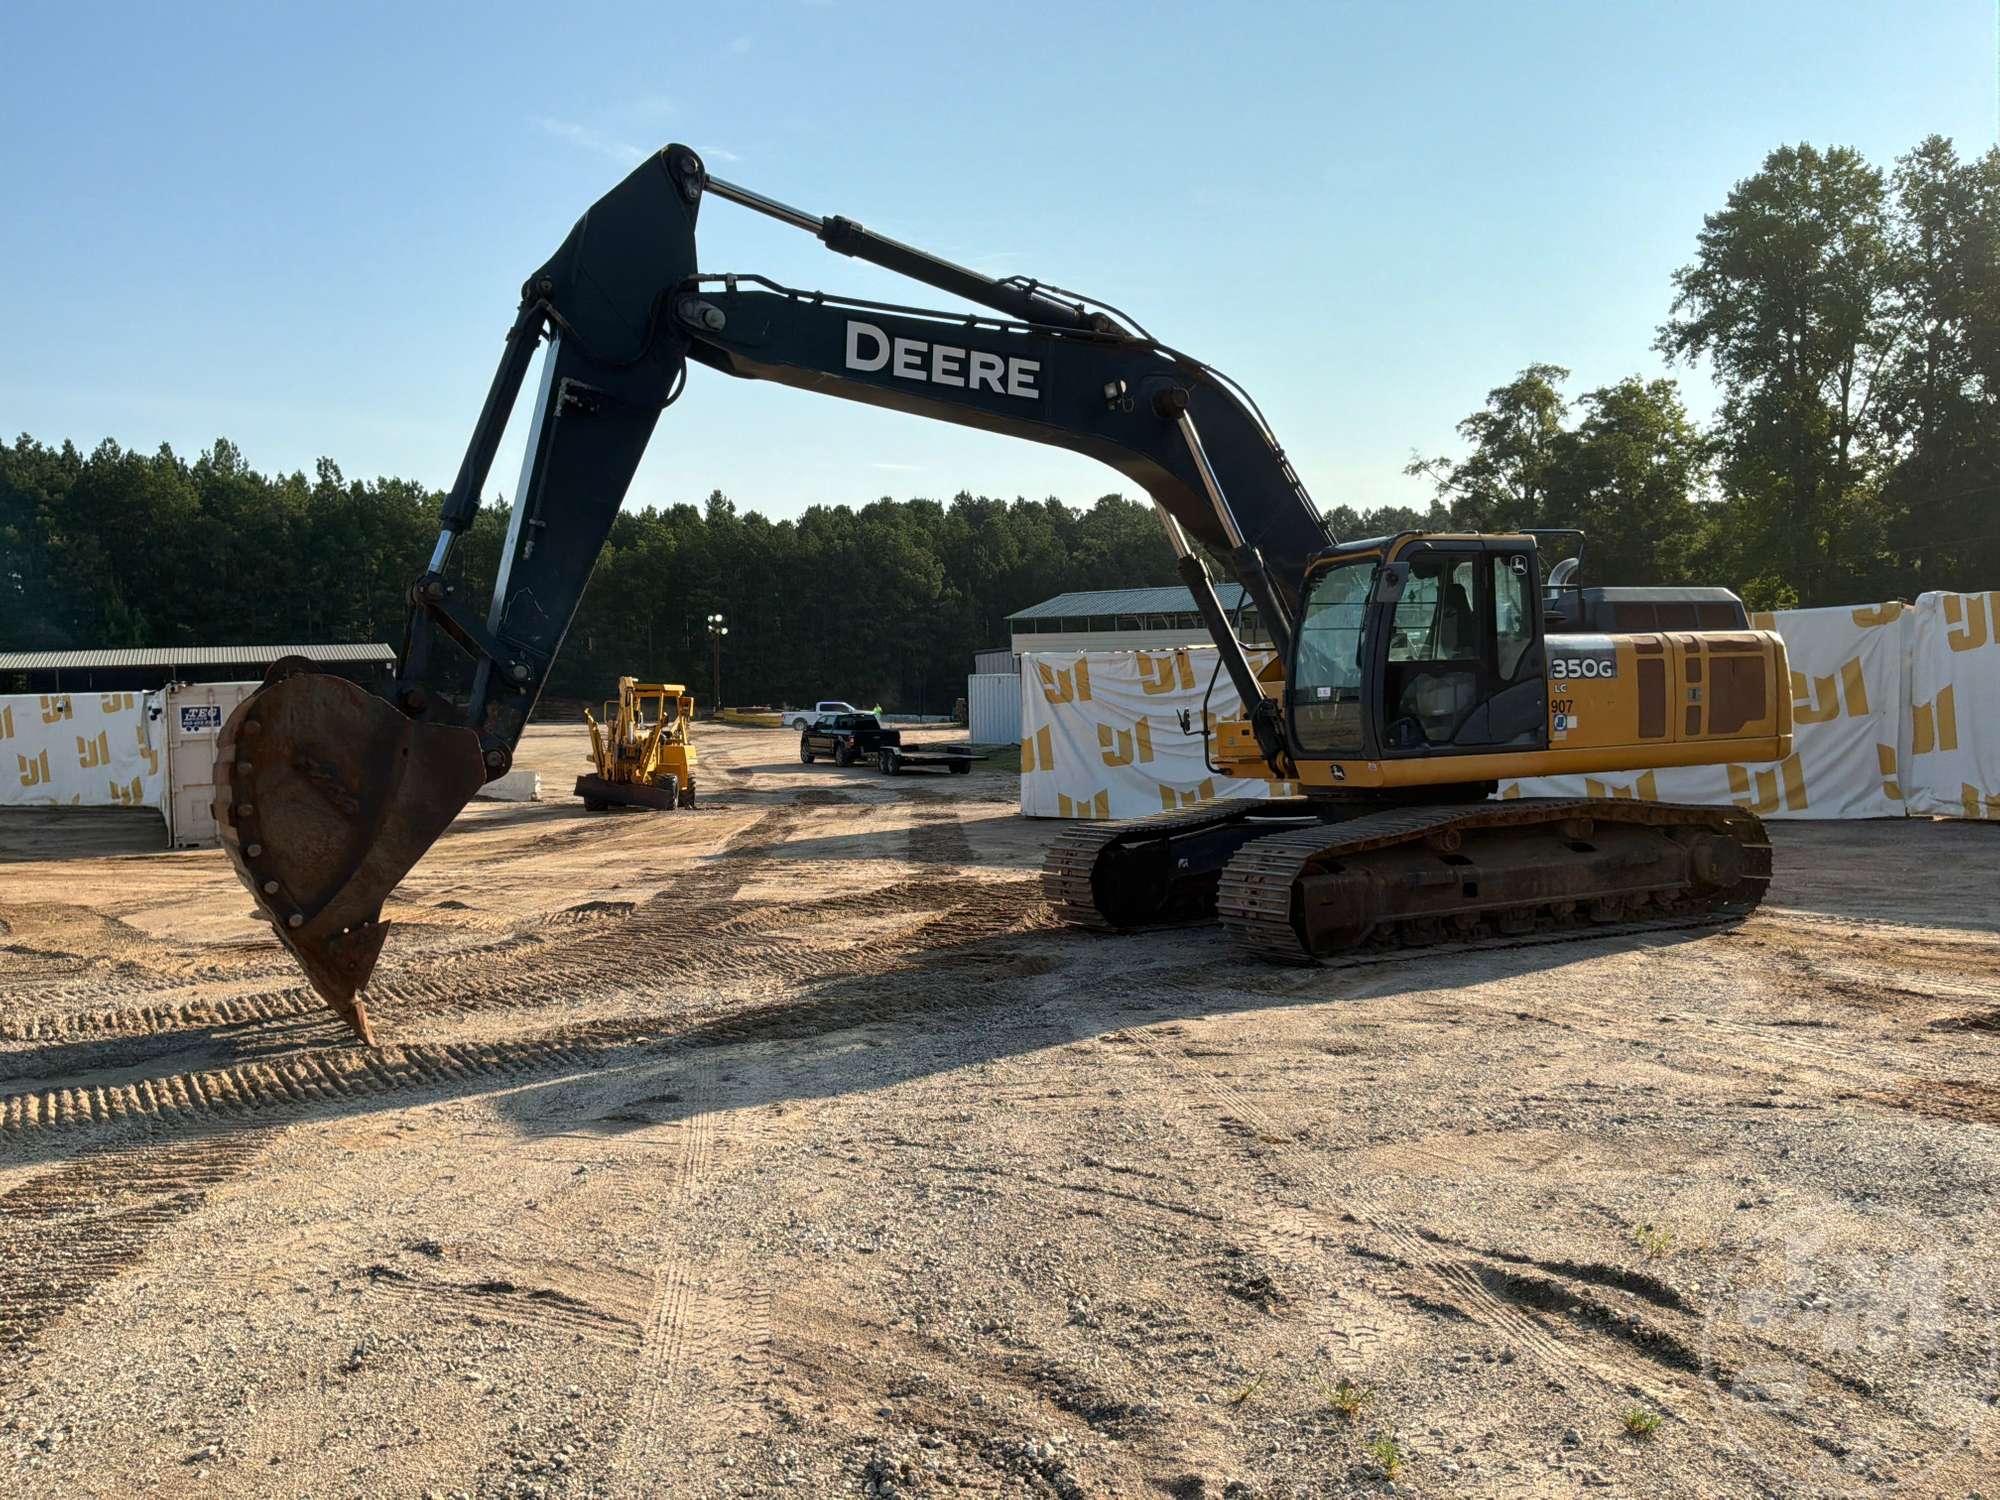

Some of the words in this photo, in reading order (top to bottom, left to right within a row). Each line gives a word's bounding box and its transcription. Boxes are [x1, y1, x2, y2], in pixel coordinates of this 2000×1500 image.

[846, 320, 1040, 399] DEERE
[1553, 659, 1613, 678] 350G
[1554, 684, 1567, 693] LC
[1551, 700, 1573, 713] 907
